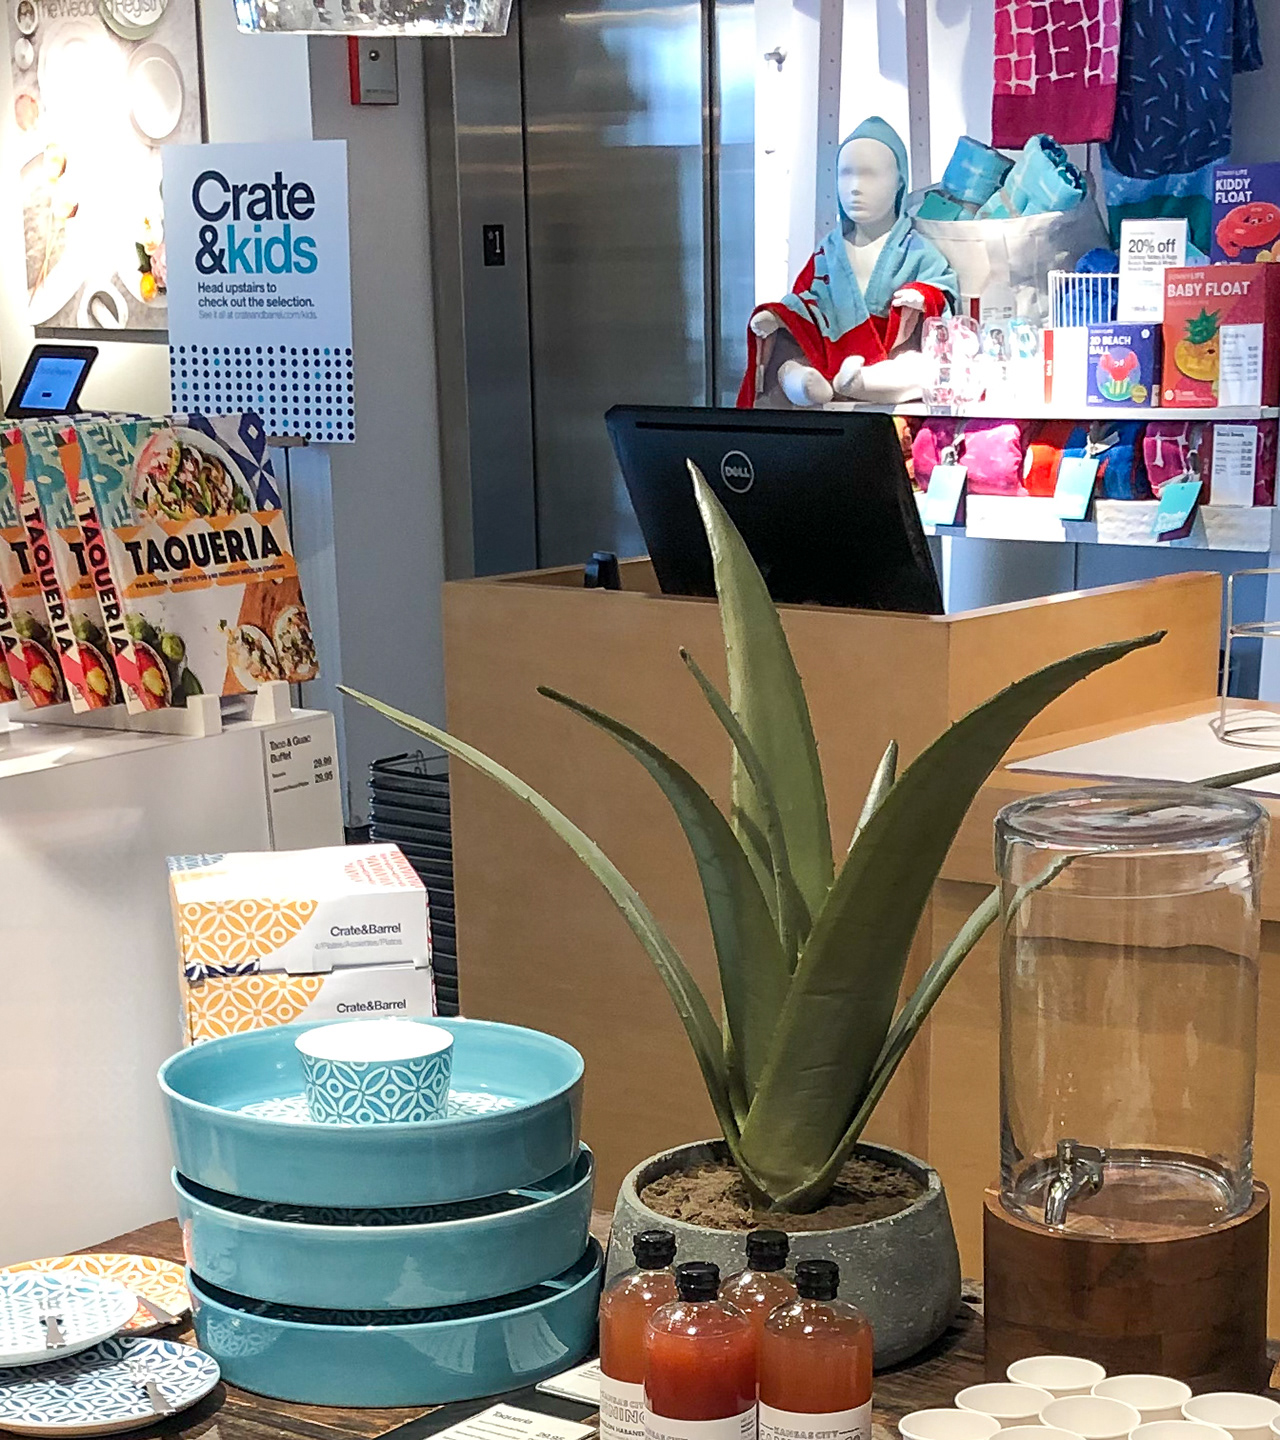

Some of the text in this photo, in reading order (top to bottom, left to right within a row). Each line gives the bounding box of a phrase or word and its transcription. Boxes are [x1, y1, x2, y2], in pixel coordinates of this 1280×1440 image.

[1216, 178, 1251, 191] KIDDY
[192, 170, 315, 222] Crate
[1215, 191, 1253, 204] FLOAT
[195, 224, 318, 275] &kids
[1128, 238, 1176, 253] 20% off
[198, 282, 277, 295] Head upstairs to
[1167, 281, 1251, 298] BABY FLOAT
[198, 295, 315, 307] check out the selection.
[724, 465, 751, 478] DELL
[124, 525, 282, 576] TAQUERIA
[24, 507, 74, 653] TAQUERIA
[79, 507, 130, 654] TAQUERIA
[330, 923, 402, 937] Crate&Barrel
[336, 999, 406, 1013] Crate&Barrel
[773, 1426, 838, 1439] KANSAS CITY
